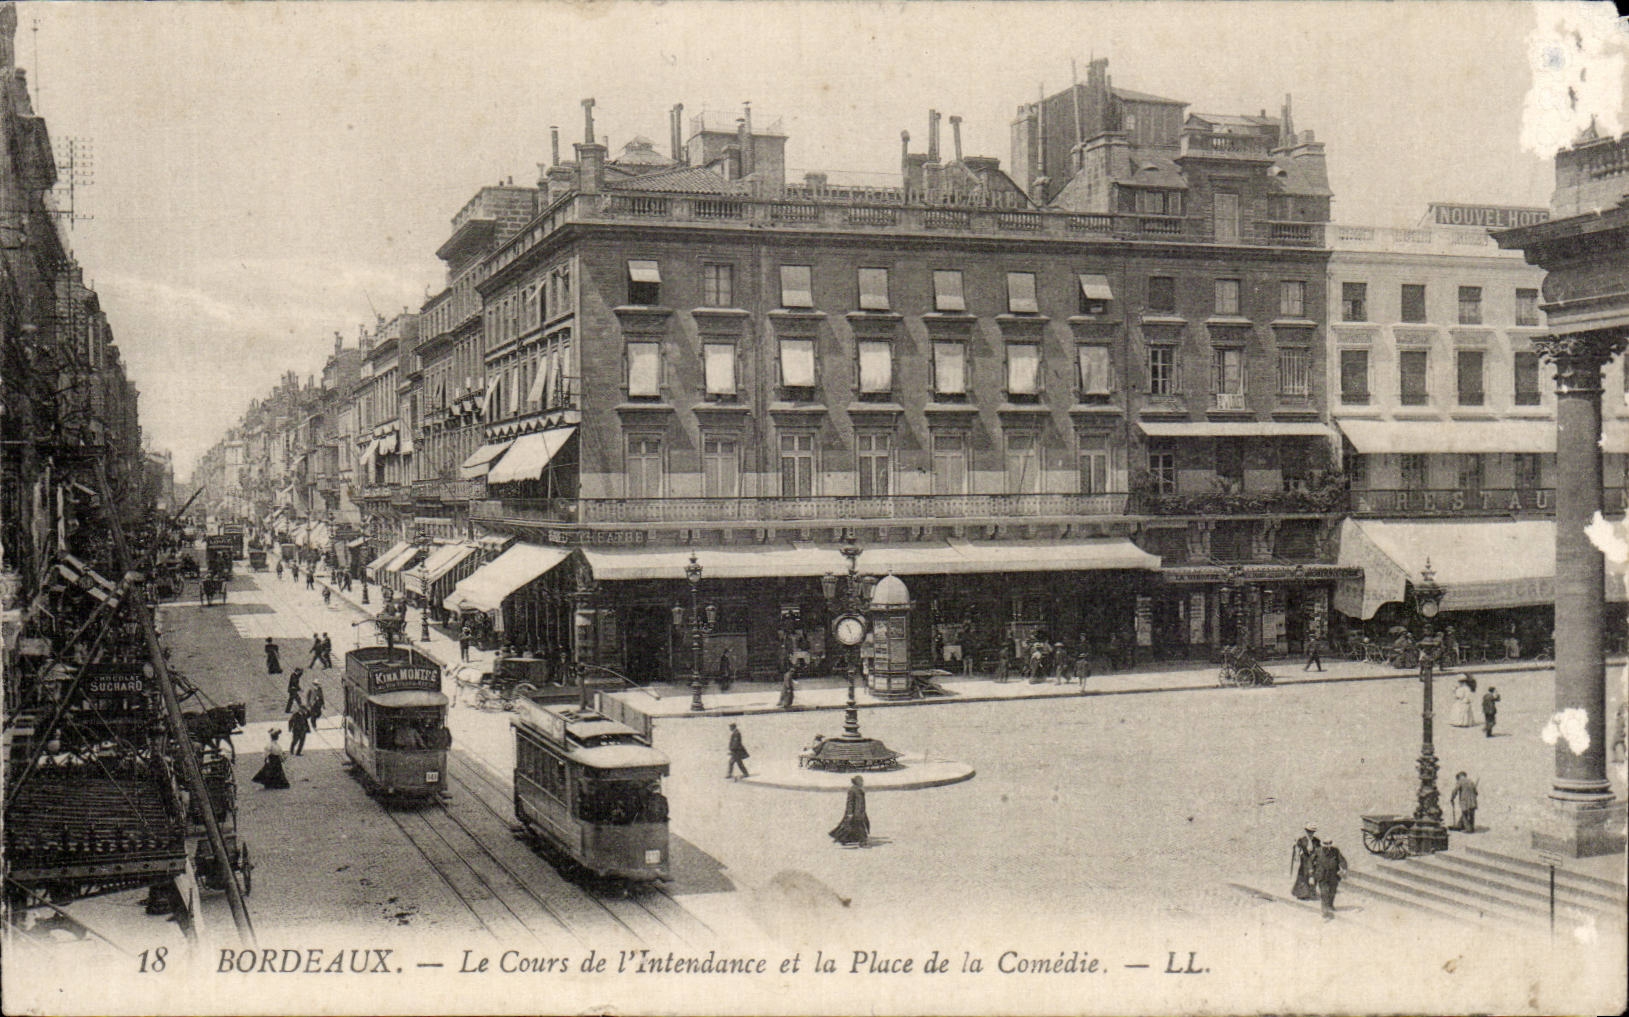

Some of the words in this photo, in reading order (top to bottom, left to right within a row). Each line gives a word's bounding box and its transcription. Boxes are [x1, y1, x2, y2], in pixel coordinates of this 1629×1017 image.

[1440, 207, 1504, 226] NOUVEL
[1508, 210, 1549, 228] HOTE
[90, 681, 143, 692] SUCHARD
